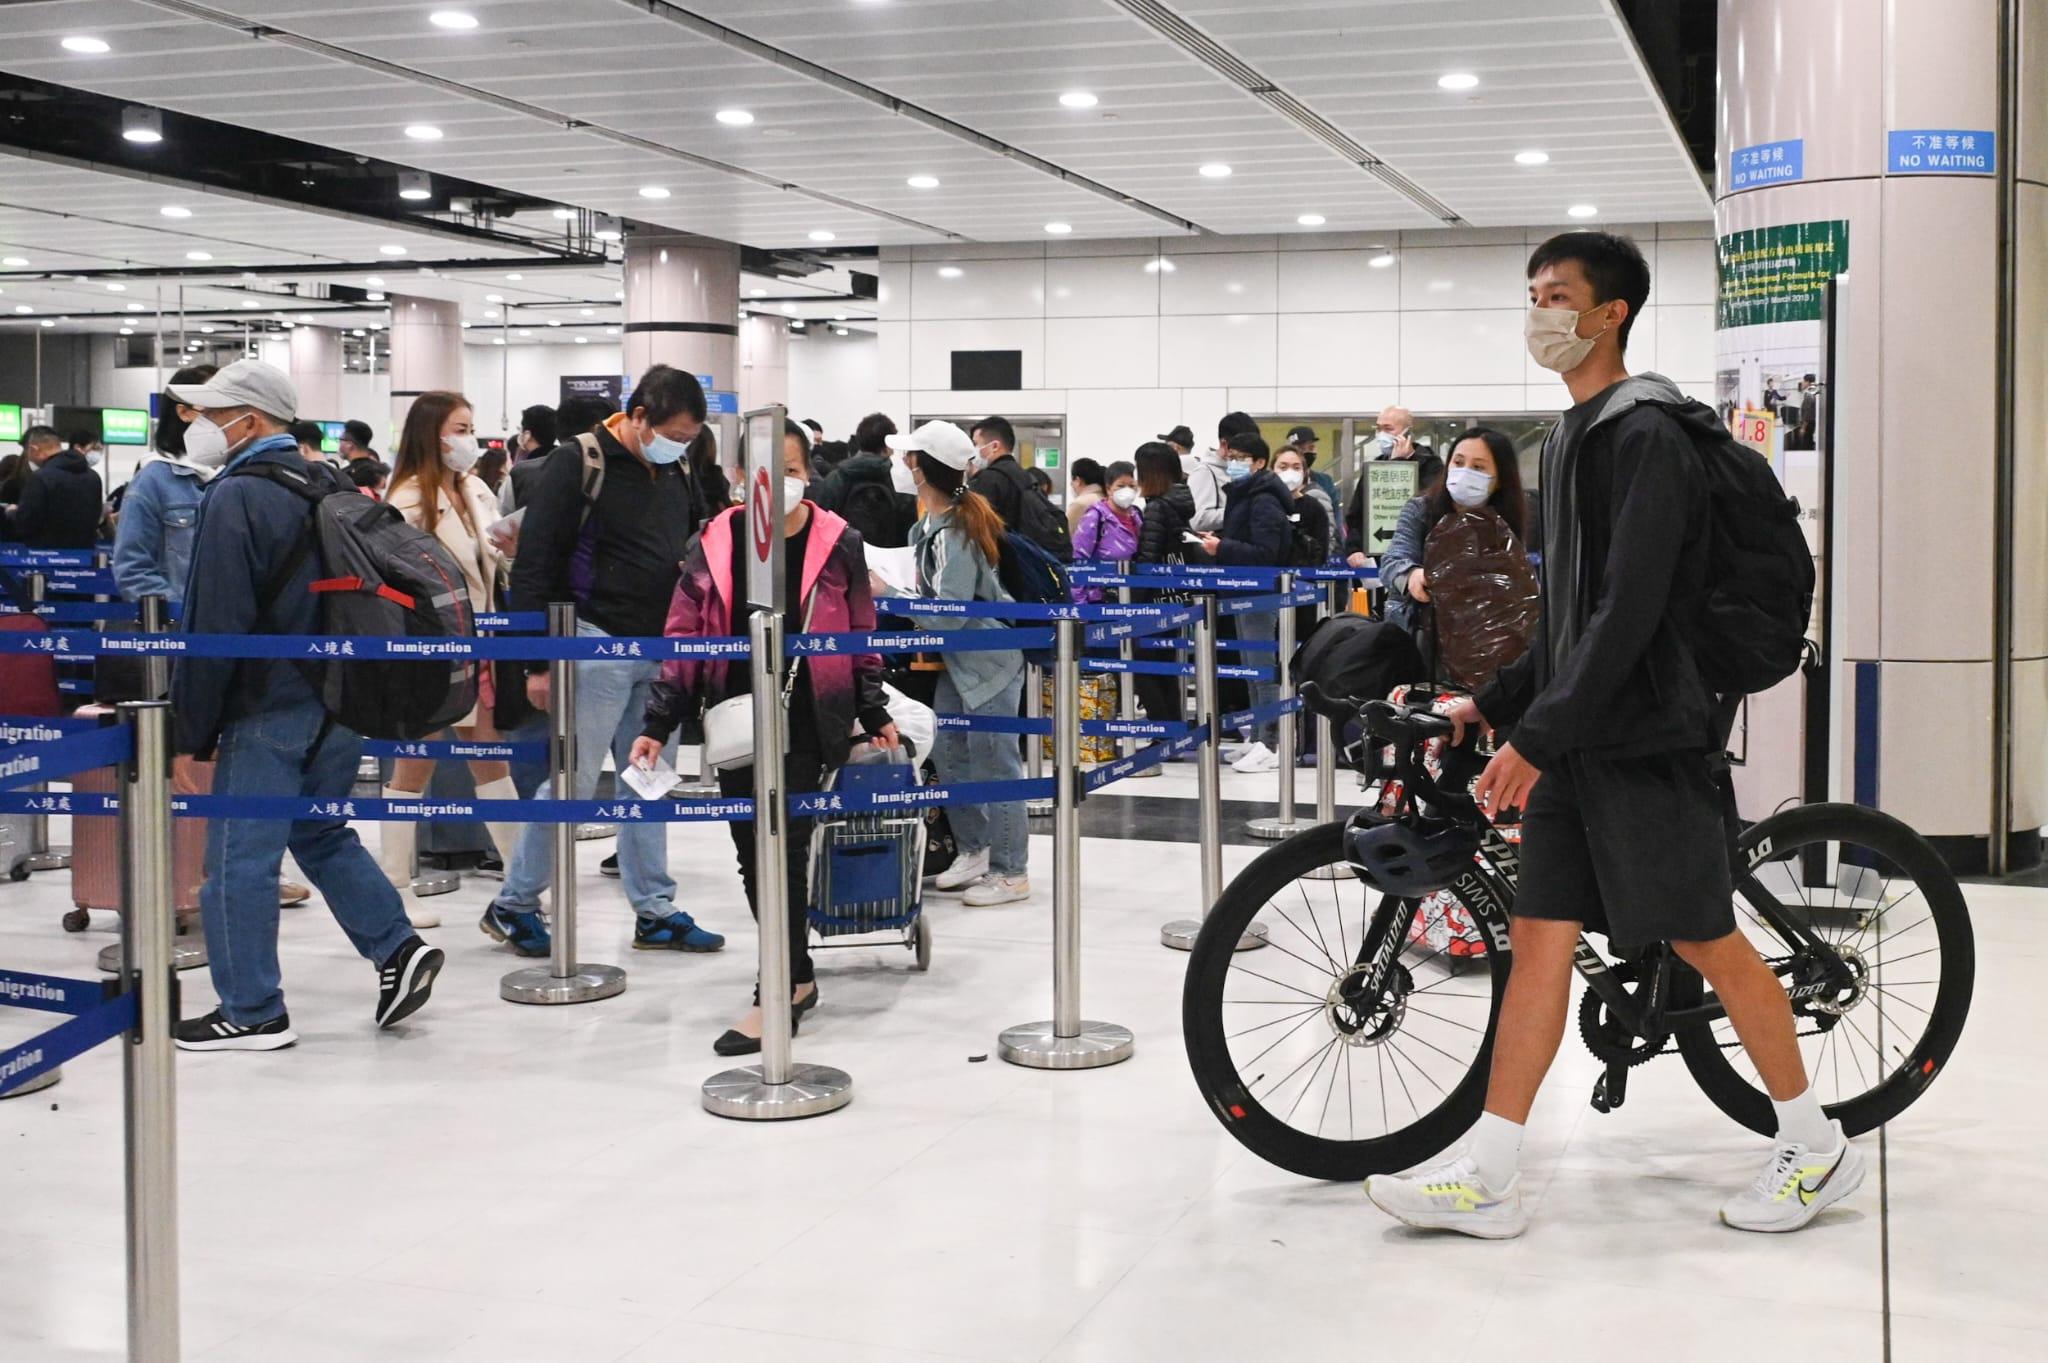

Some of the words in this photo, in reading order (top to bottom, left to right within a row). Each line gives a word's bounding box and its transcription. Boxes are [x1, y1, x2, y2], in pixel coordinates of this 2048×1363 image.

[1911, 135, 1975, 150] 不准等候
[1899, 154, 1920, 167] NO
[1927, 154, 1985, 167] WAITING
[1735, 172, 1746, 185] NO
[1749, 164, 1793, 182] WAITING
[909, 601, 966, 612] Immigration
[1101, 606, 1162, 617] Immigration
[23, 636, 71, 652] 入境處
[101, 637, 187, 652] Immigration
[307, 640, 356, 656] 入境處
[386, 640, 472, 656] Immigration
[593, 641, 642, 657] 入境處
[674, 640, 751, 656] Immigratio
[792, 637, 839, 652] 入境處
[866, 634, 945, 649] Immigration
[1105, 723, 1166, 734] Immigration
[451, 744, 513, 758] Immigration
[25, 797, 72, 811] 入境處
[798, 795, 843, 811] 入境處
[871, 788, 949, 804] Immigration
[309, 801, 357, 817] 入境處
[387, 802, 473, 818] Immigration
[596, 804, 643, 819] 入境處
[675, 803, 752, 818] Immigratio
[1455, 872, 1497, 917] SWIS
[1370, 900, 1408, 997] SPECIALIZED
